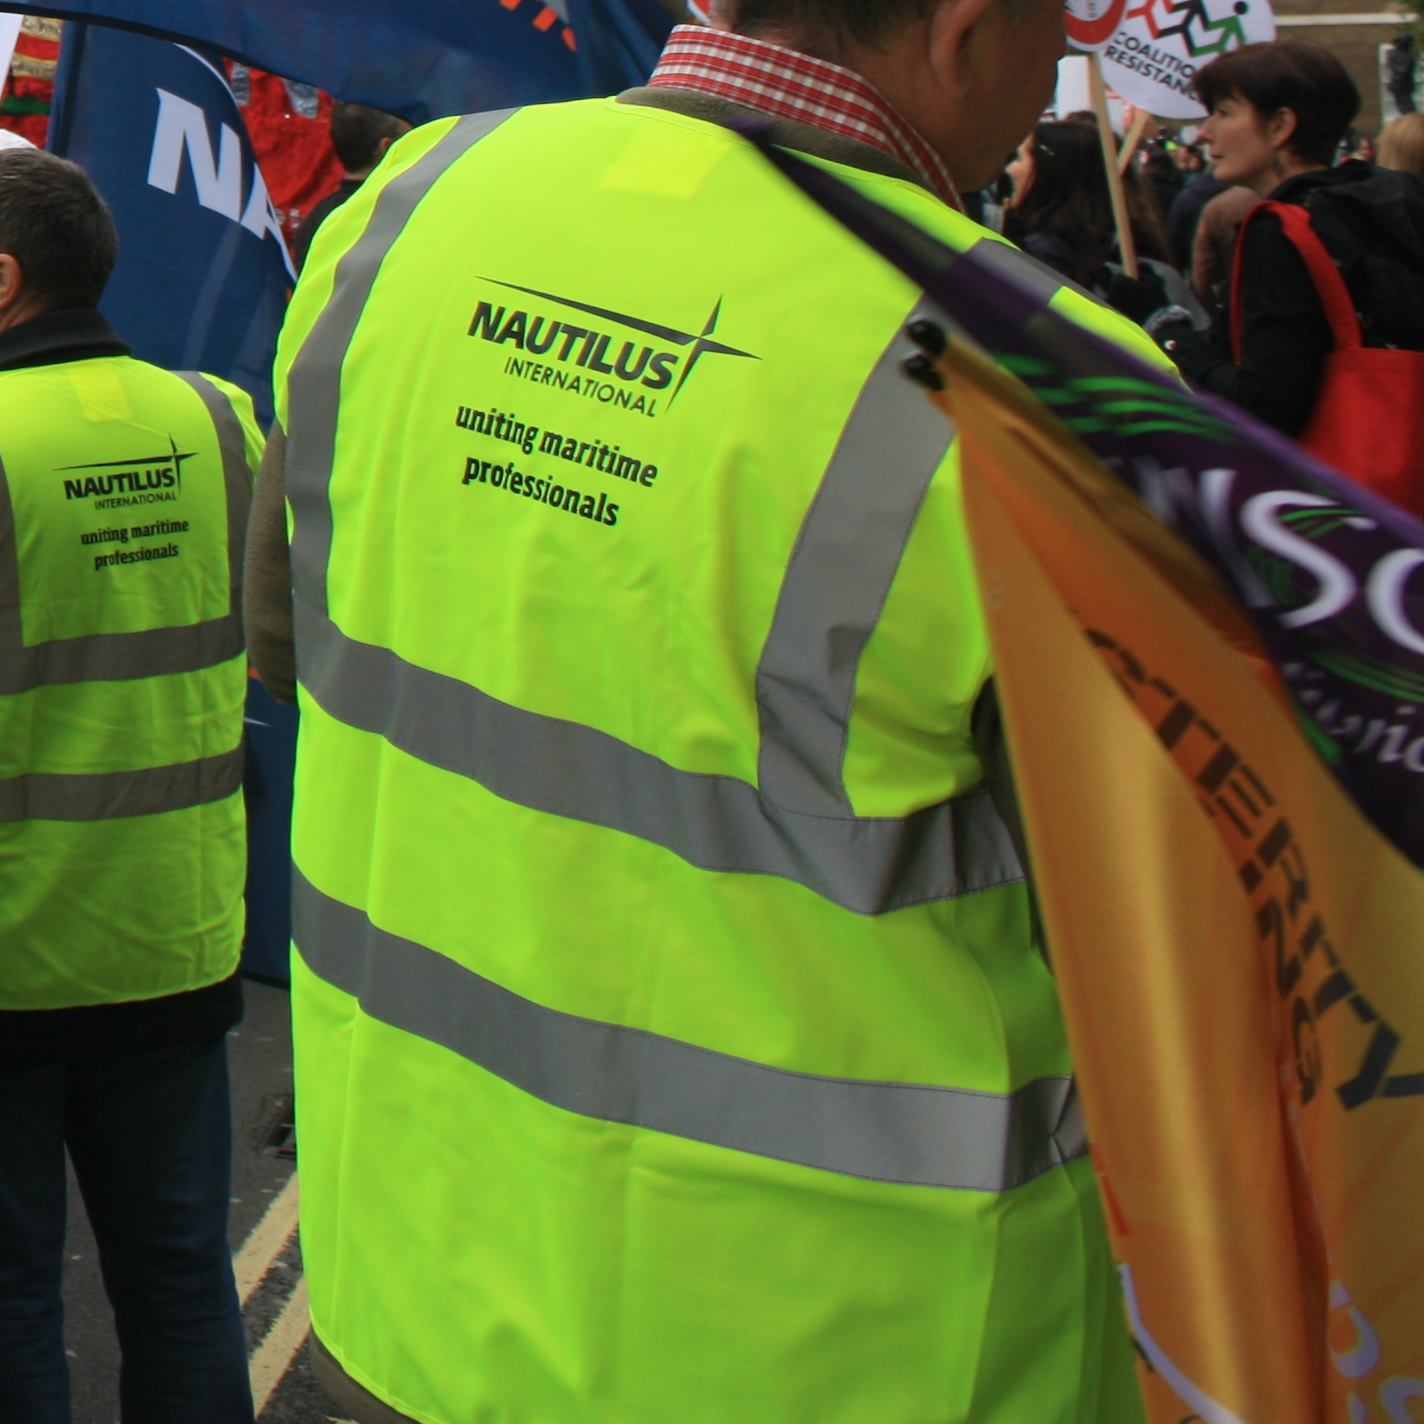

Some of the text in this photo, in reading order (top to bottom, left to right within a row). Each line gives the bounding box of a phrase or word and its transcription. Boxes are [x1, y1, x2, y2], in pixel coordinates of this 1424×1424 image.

[467, 300, 679, 390] NAUTILUS
[503, 356, 656, 417] INTERNATIONAL
[455, 404, 659, 488] uniting maritime
[63, 467, 176, 500] NAUTILUS
[94, 491, 177, 510] INTERNATIONAL
[462, 456, 619, 527] professionals
[80, 519, 190, 546] uniting maritime
[94, 543, 179, 571] professionals
